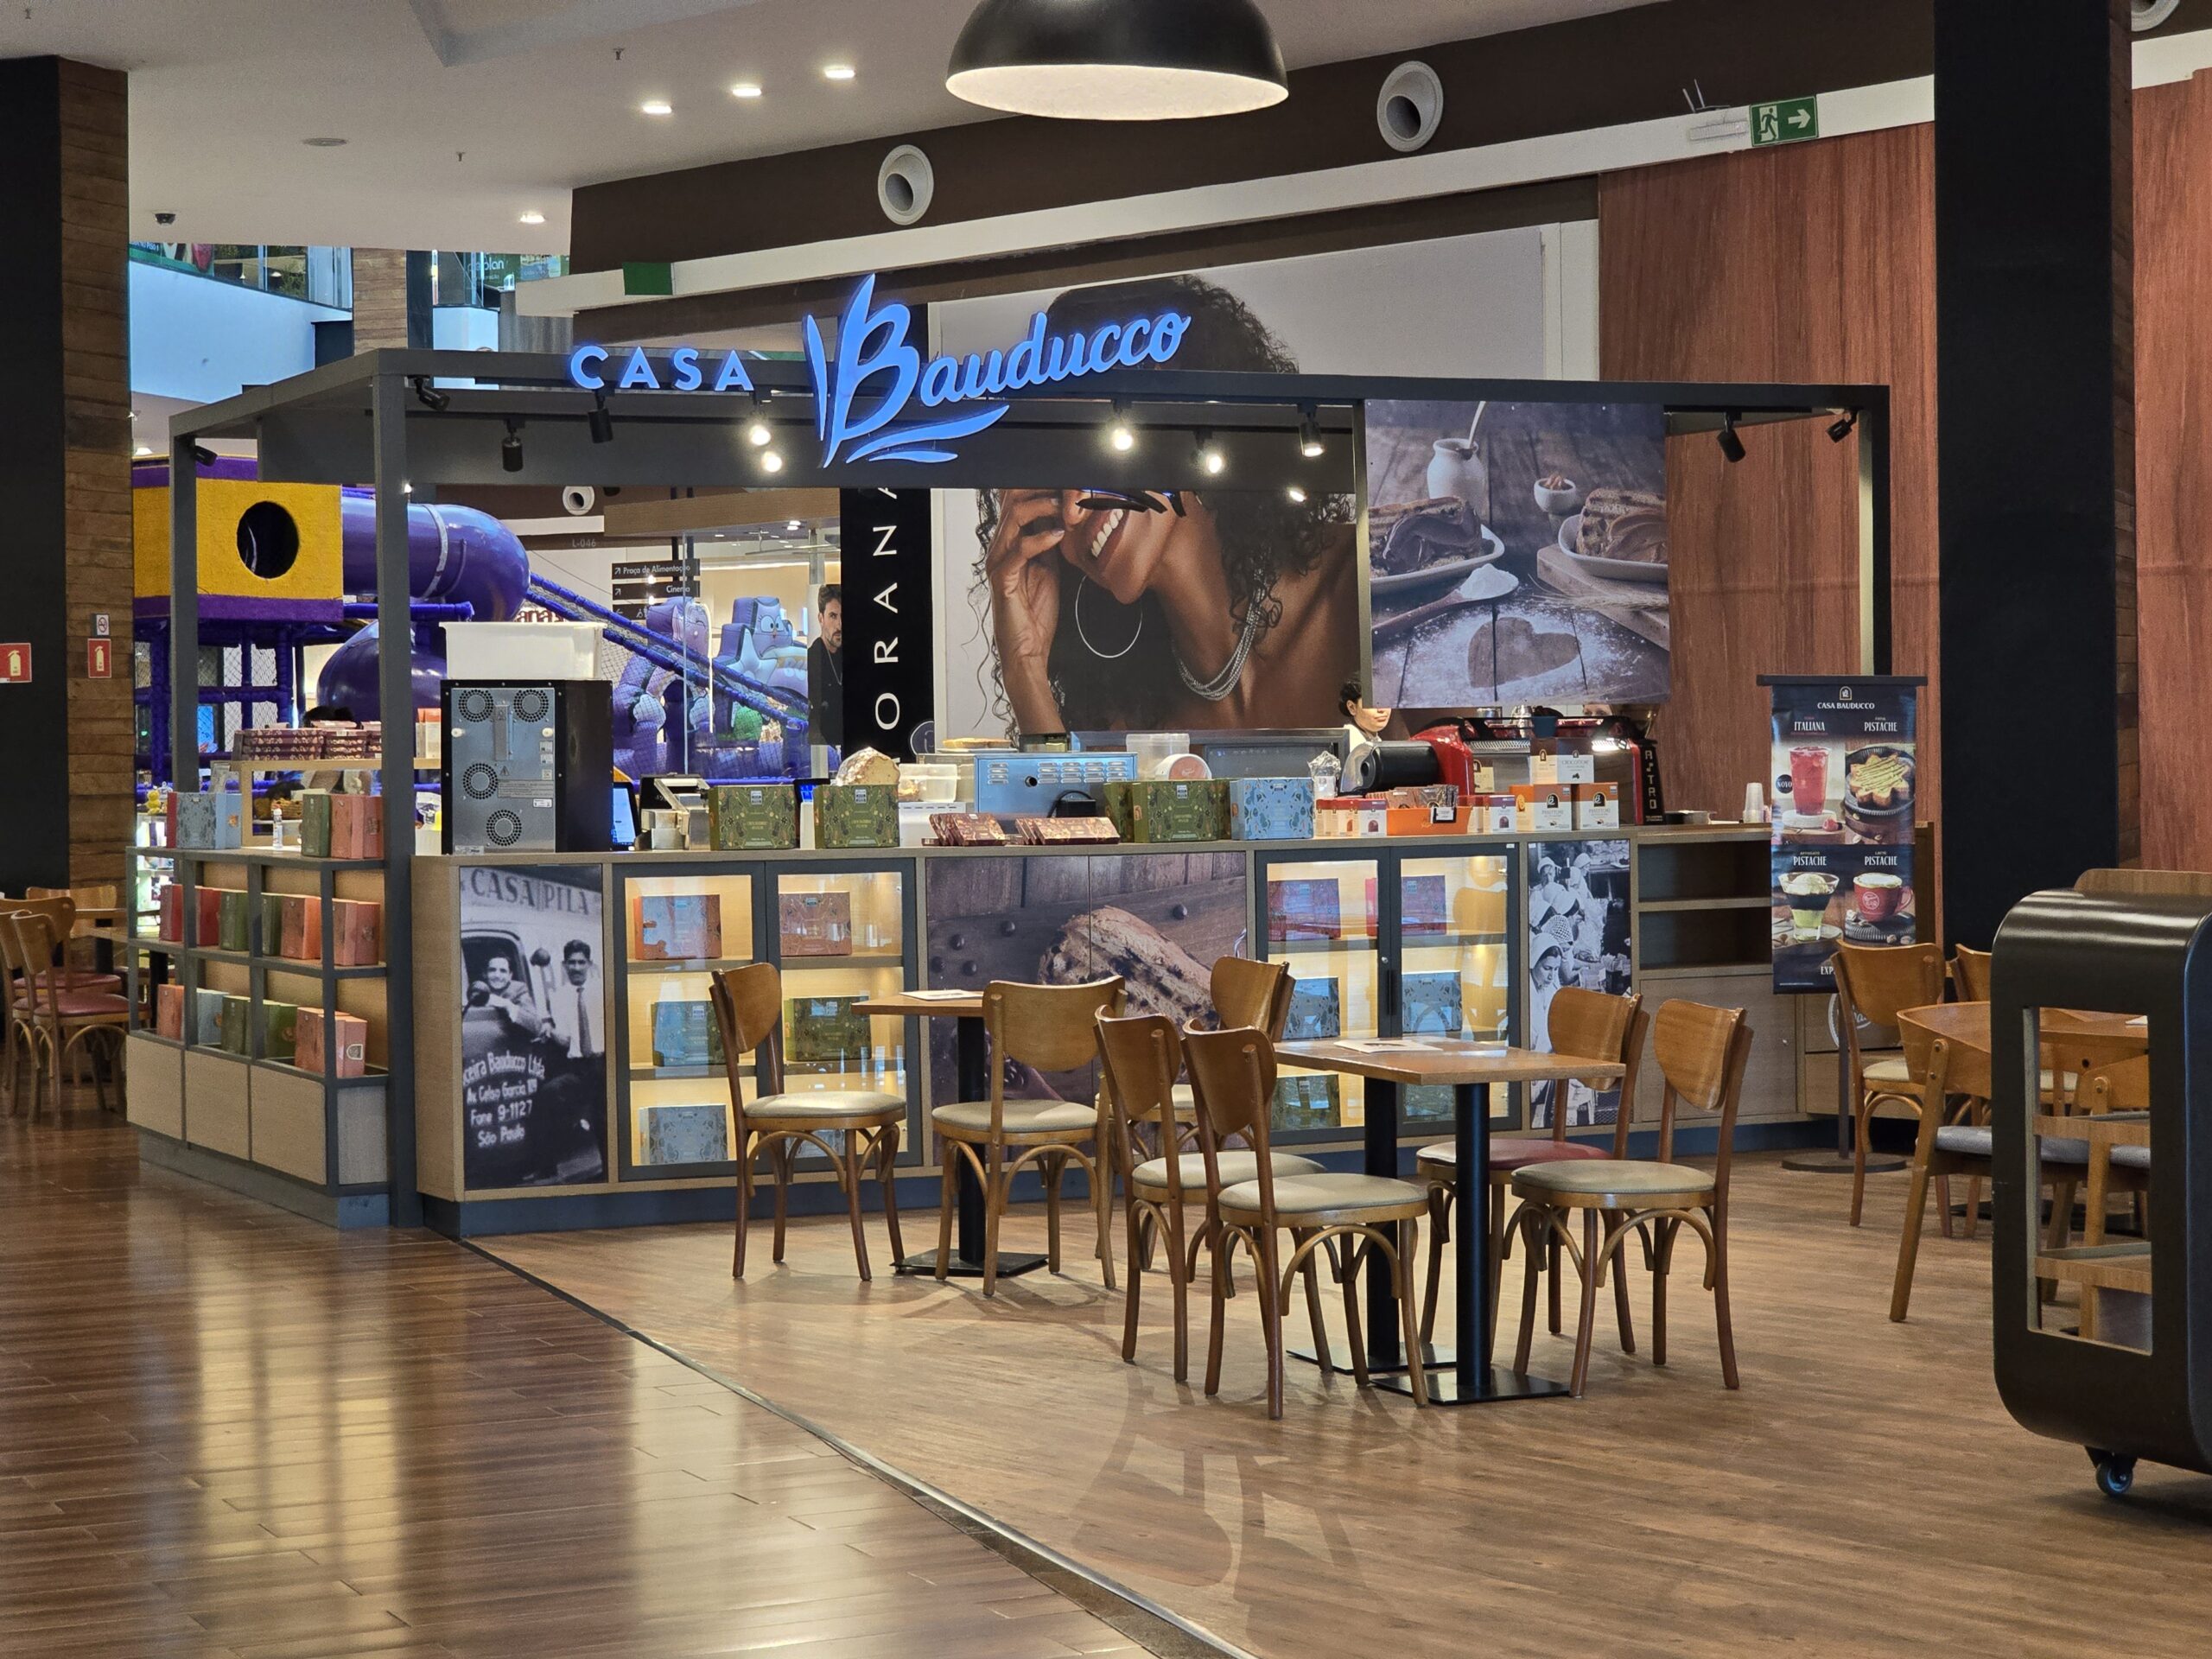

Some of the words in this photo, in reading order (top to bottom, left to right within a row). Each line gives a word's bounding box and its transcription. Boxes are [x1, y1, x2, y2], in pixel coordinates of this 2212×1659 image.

[570, 346, 754, 391] CASA
[804, 273, 1192, 468] Bauducco
[572, 538, 596, 548] L-046
[623, 567, 640, 575] Praça
[873, 487, 900, 763] ORAN
[1794, 721, 1826, 732] ITALIANA
[1864, 721, 1898, 732] PISTACHE
[1793, 855, 1827, 866] PISTACHE
[1864, 855, 1898, 866] PISTACHE
[470, 868, 536, 907] CASA
[1821, 966, 1835, 976] EXP
[498, 1099, 533, 1122] 9-1127
